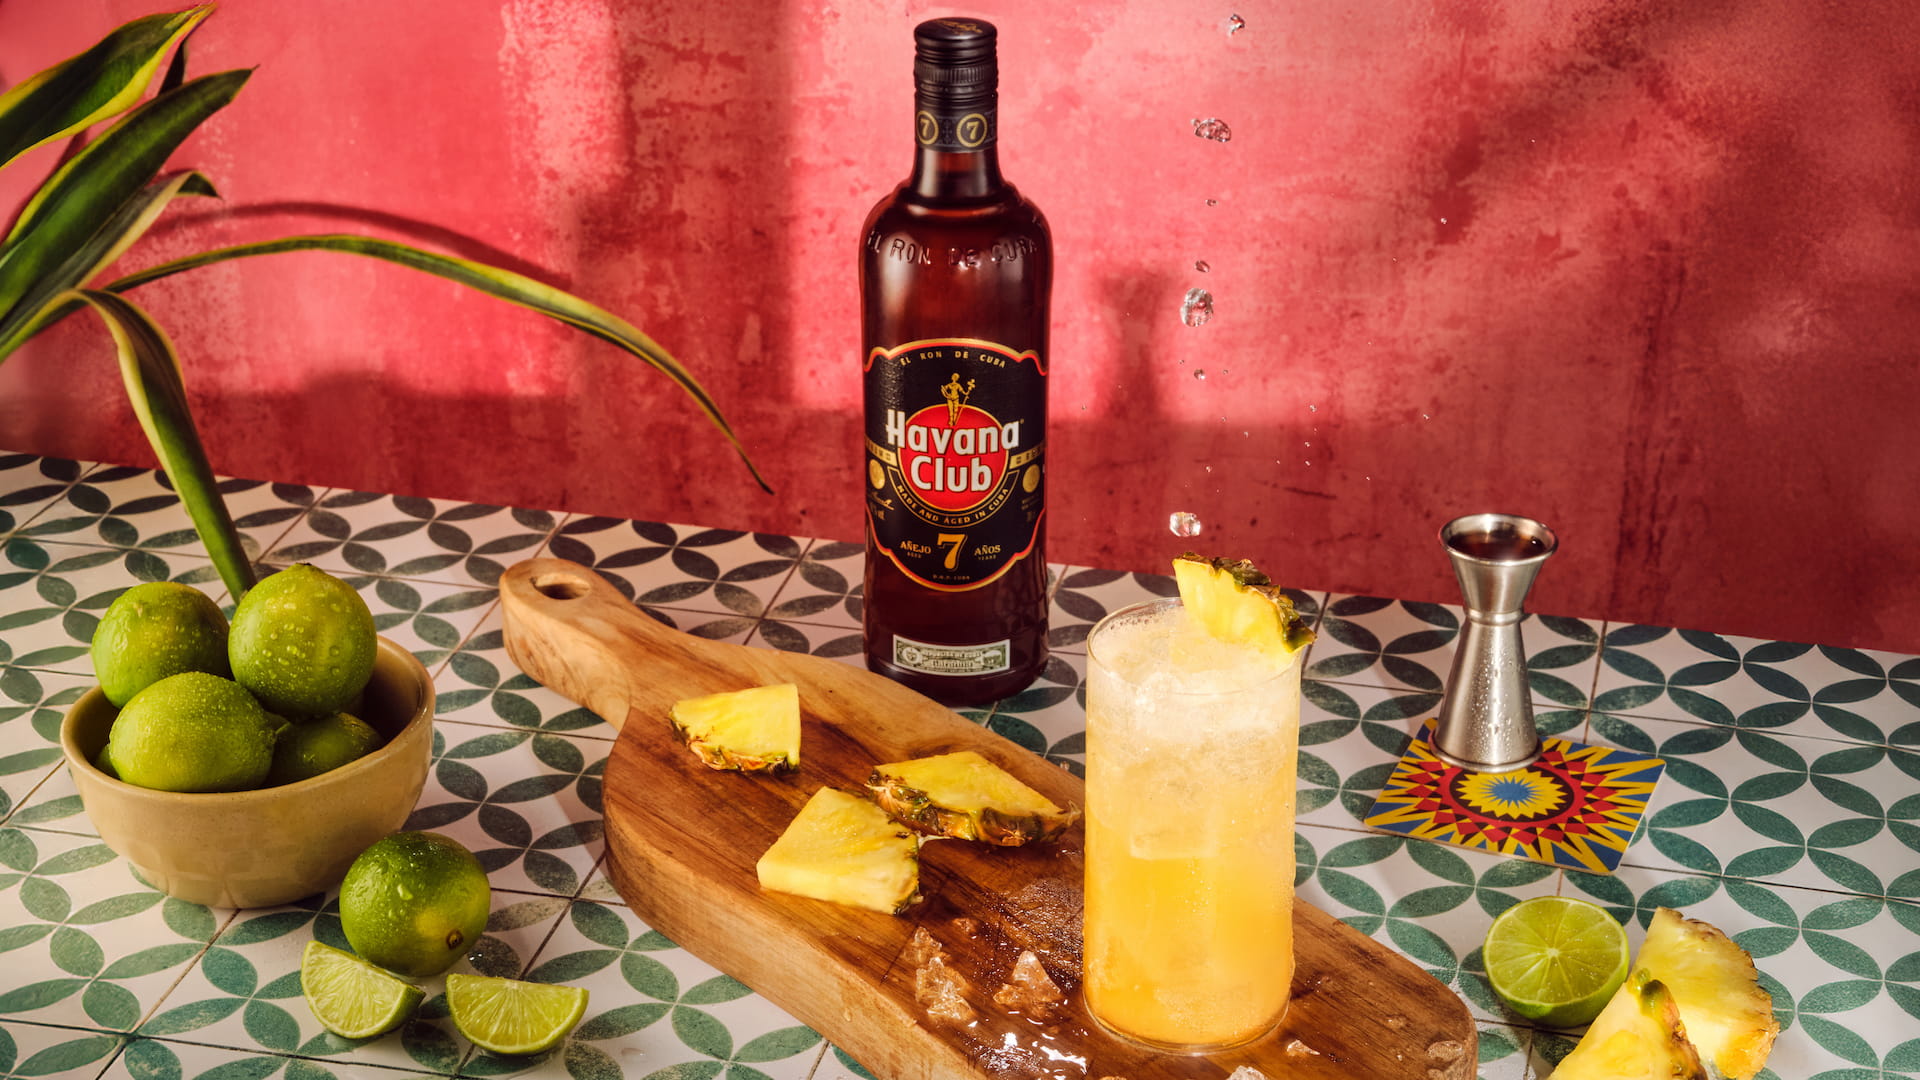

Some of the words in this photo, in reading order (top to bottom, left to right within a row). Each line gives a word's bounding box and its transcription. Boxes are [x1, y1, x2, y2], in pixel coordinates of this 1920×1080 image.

[920, 118, 931, 137] 7
[966, 121, 979, 140] 7
[889, 238, 932, 265] RON
[900, 356, 911, 366] EL
[920, 351, 942, 360] RON
[954, 350, 969, 359] DE
[979, 354, 1006, 368] CUBA
[885, 408, 1020, 454] Havana
[910, 455, 993, 493] Club
[897, 485, 917, 509] MADE
[919, 509, 939, 521] AND
[943, 516, 971, 525] AGED
[975, 510, 986, 520] IN
[988, 488, 1009, 511] CUBA
[900, 540, 932, 554] AÑEJO
[937, 532, 968, 571] 7
[974, 544, 1001, 556] AÑOS
